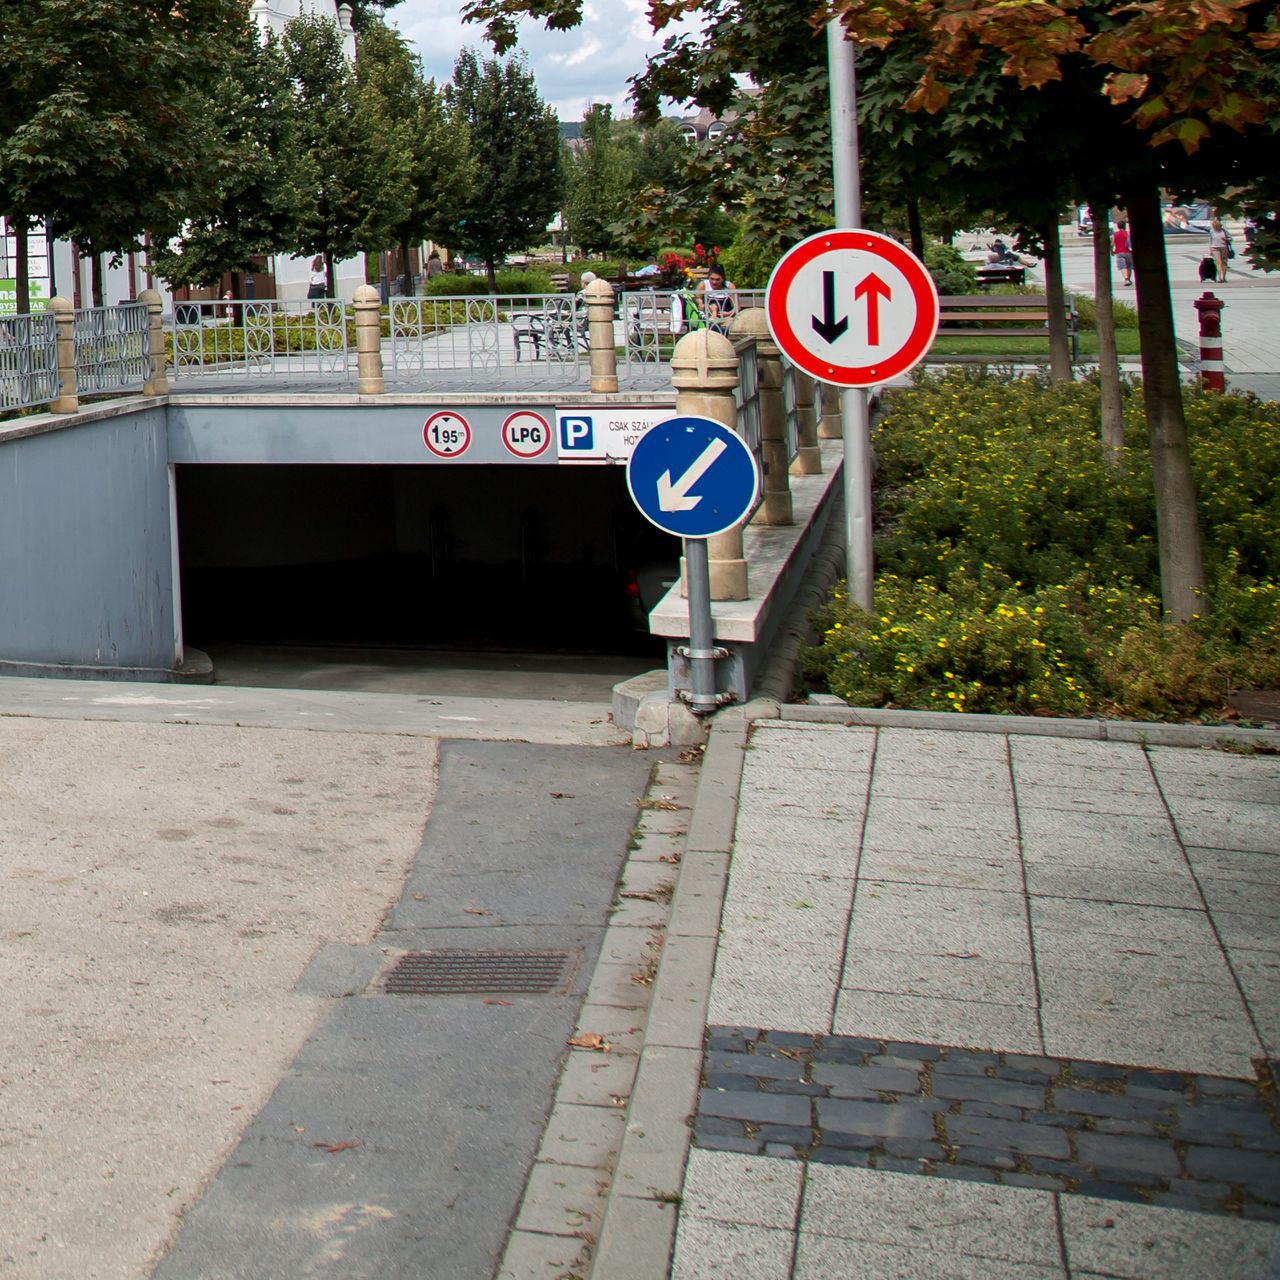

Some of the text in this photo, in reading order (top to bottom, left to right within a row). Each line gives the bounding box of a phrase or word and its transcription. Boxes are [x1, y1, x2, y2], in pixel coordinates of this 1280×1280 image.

[567, 420, 589, 447] P
[608, 421, 629, 431] CSAK
[511, 428, 541, 443] LPG
